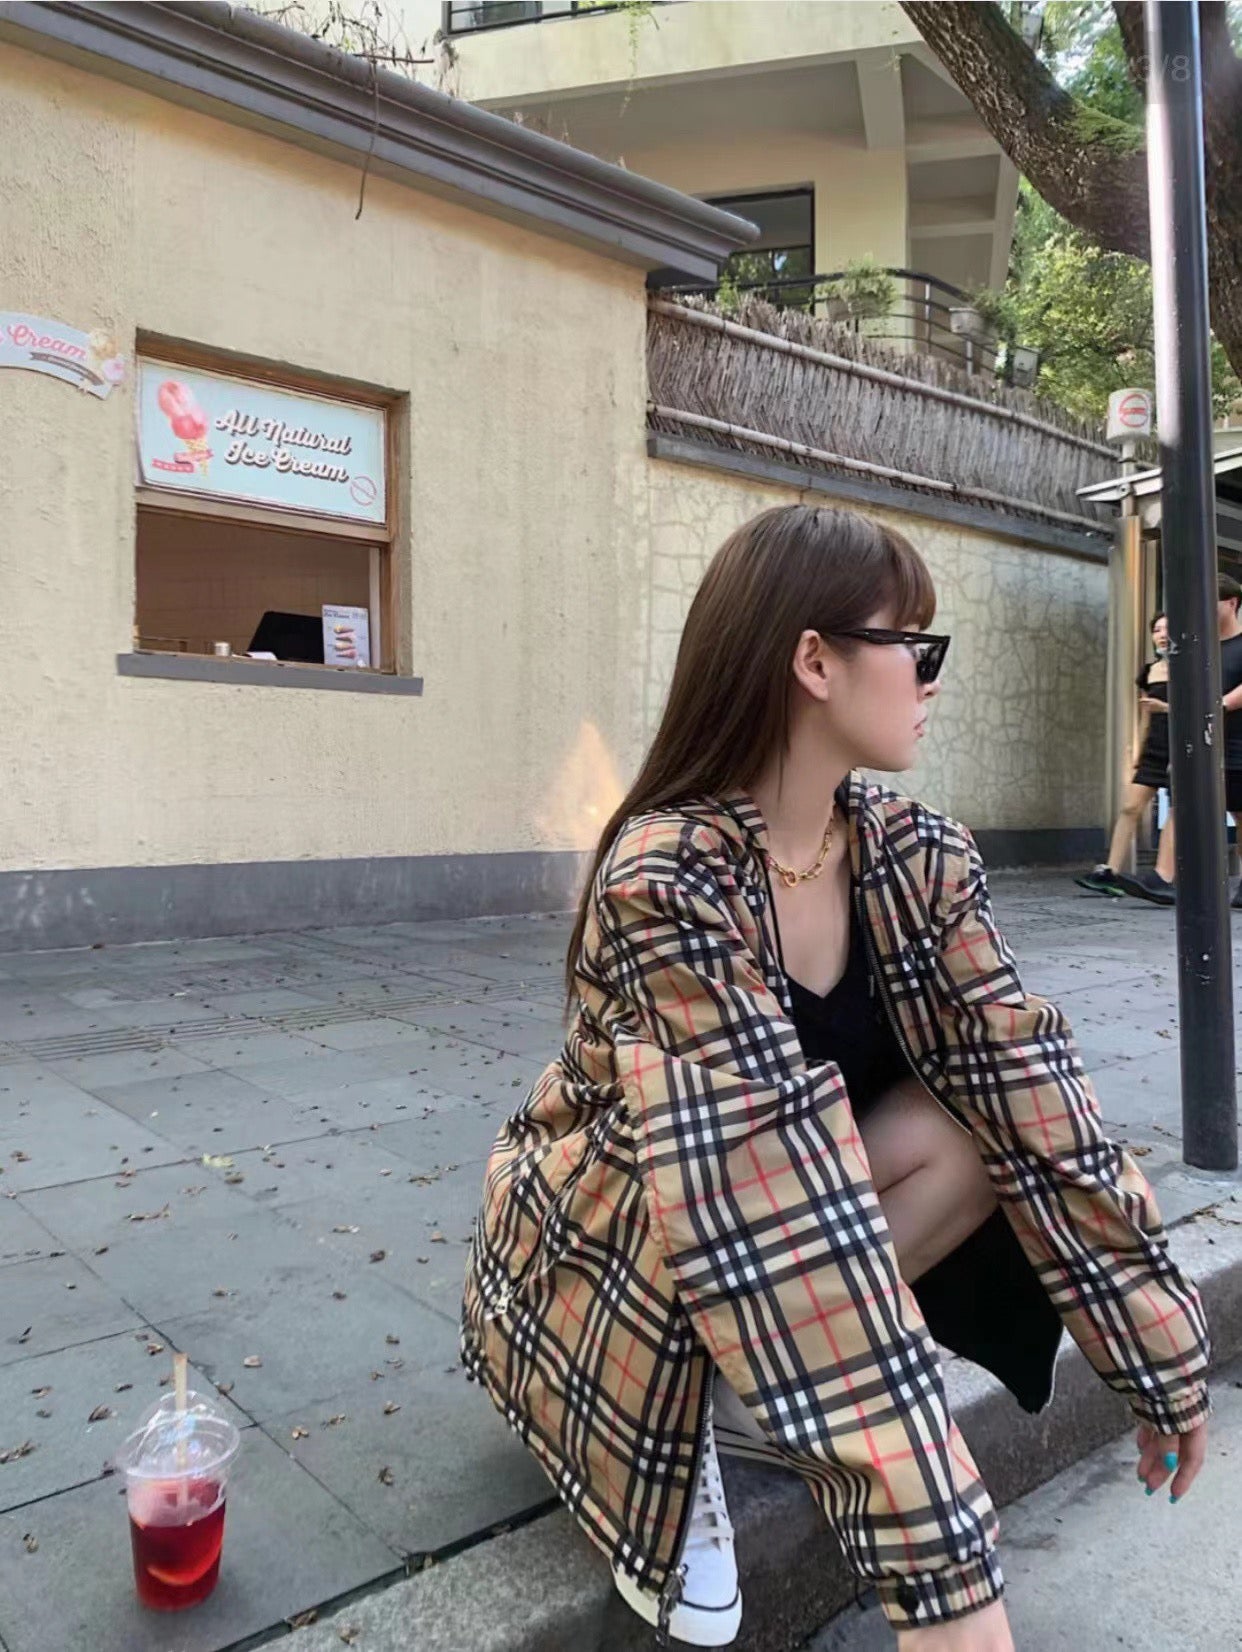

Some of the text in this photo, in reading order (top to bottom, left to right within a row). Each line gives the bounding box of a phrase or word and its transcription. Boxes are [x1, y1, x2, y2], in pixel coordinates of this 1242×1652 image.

[7, 323, 86, 358] Cream
[216, 409, 352, 455] All Natural
[224, 440, 271, 468] Ice
[271, 447, 349, 483] Cream
